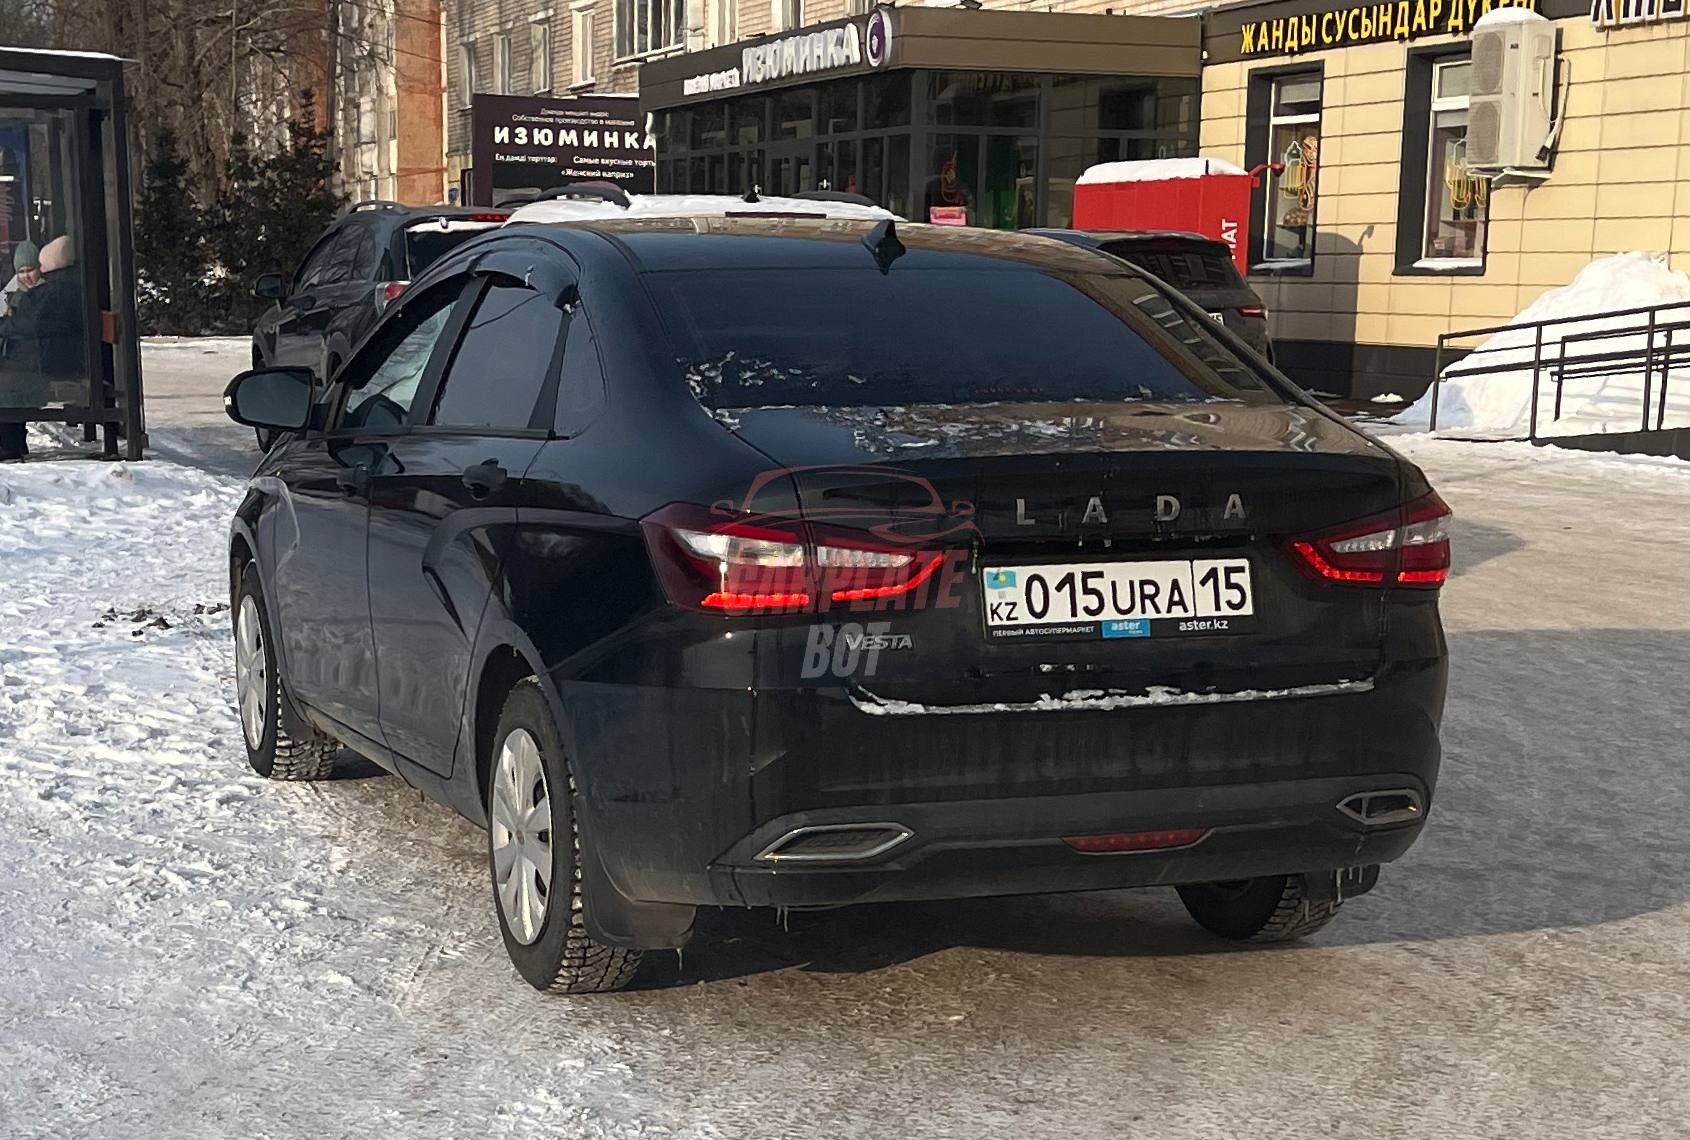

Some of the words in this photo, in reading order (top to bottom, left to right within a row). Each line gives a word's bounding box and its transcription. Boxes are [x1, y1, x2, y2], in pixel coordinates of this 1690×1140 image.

[1241, 14, 1317, 54] ЖАНДЫ
[1322, 0, 1442, 44] СУСЫНДАР
[494, 126, 657, 150] ИЗЮМИНКА
[1016, 494, 1247, 526] LADA
[1199, 566, 1247, 612] 15
[990, 601, 1019, 622] KZ
[1111, 620, 1141, 631] aster
[1179, 619, 1229, 632] aster.kz
[845, 633, 913, 651] VESTA
